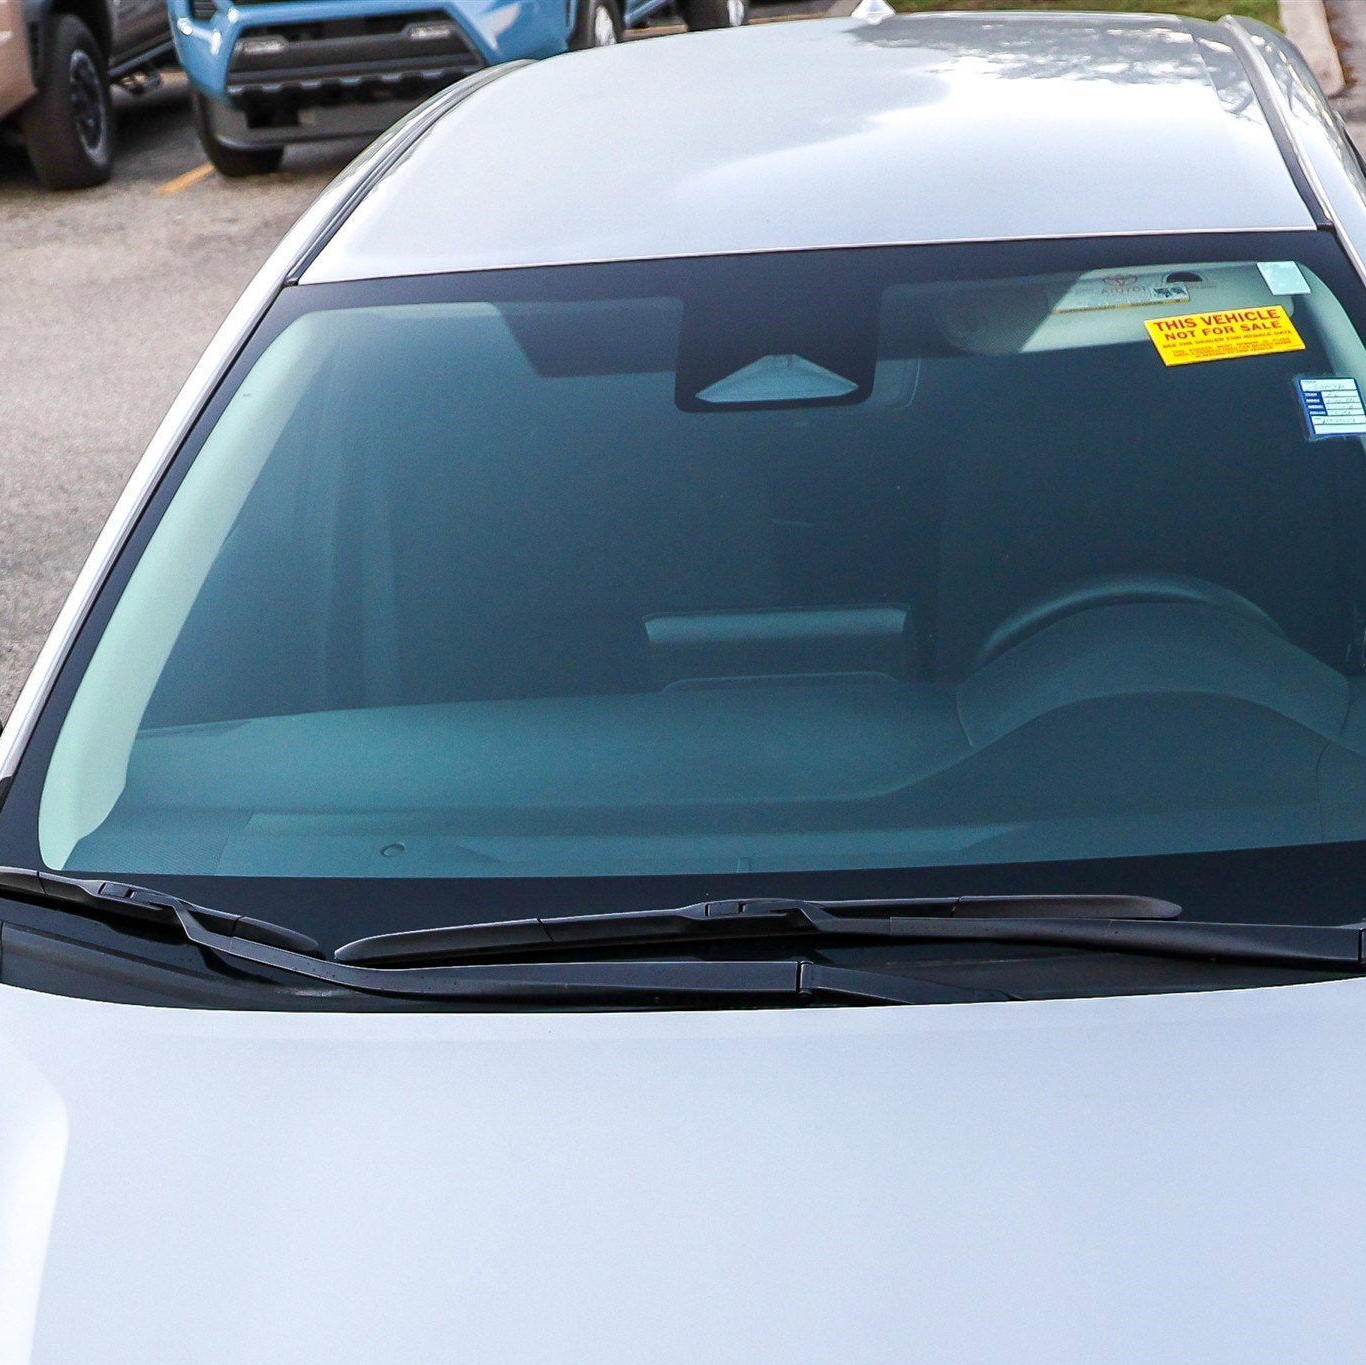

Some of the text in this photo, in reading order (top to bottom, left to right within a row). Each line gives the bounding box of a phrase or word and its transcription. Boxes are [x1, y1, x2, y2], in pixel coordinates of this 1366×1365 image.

[1153, 309, 1281, 331] THIS VEHICLE
[1164, 330, 1196, 341] NOT
[1203, 326, 1235, 336] FOR
[1241, 320, 1282, 332] SALE
